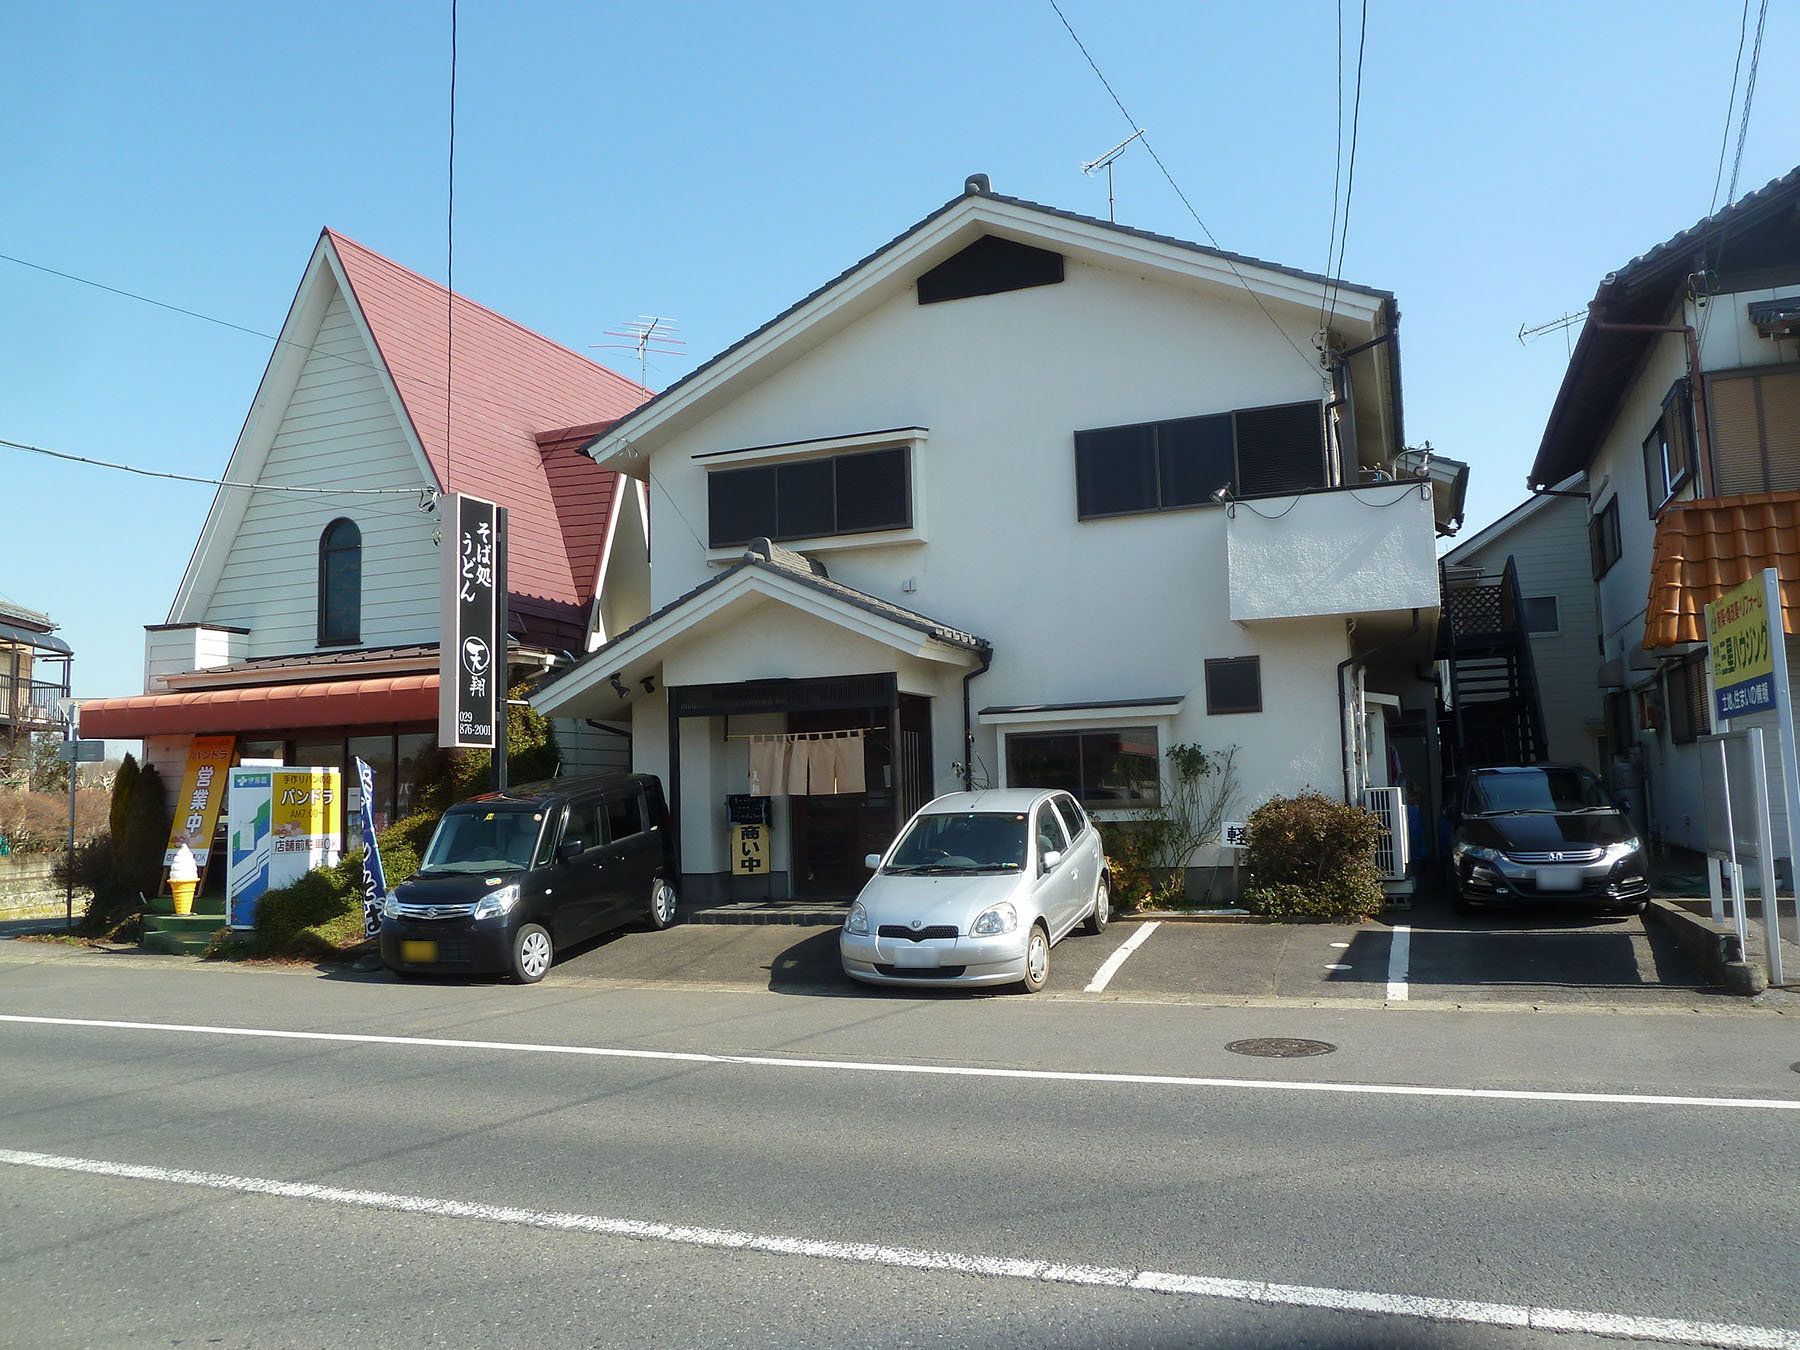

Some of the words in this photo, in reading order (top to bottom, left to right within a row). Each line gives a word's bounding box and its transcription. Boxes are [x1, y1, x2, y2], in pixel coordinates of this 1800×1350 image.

[459, 532, 477, 603] うどん
[476, 522, 492, 588] そば処
[459, 711, 473, 722] 029
[459, 724, 492, 736] 876-2001
[186, 765, 215, 834] 営業中
[281, 787, 334, 806] パンドラ
[740, 825, 761, 872] 商い中
